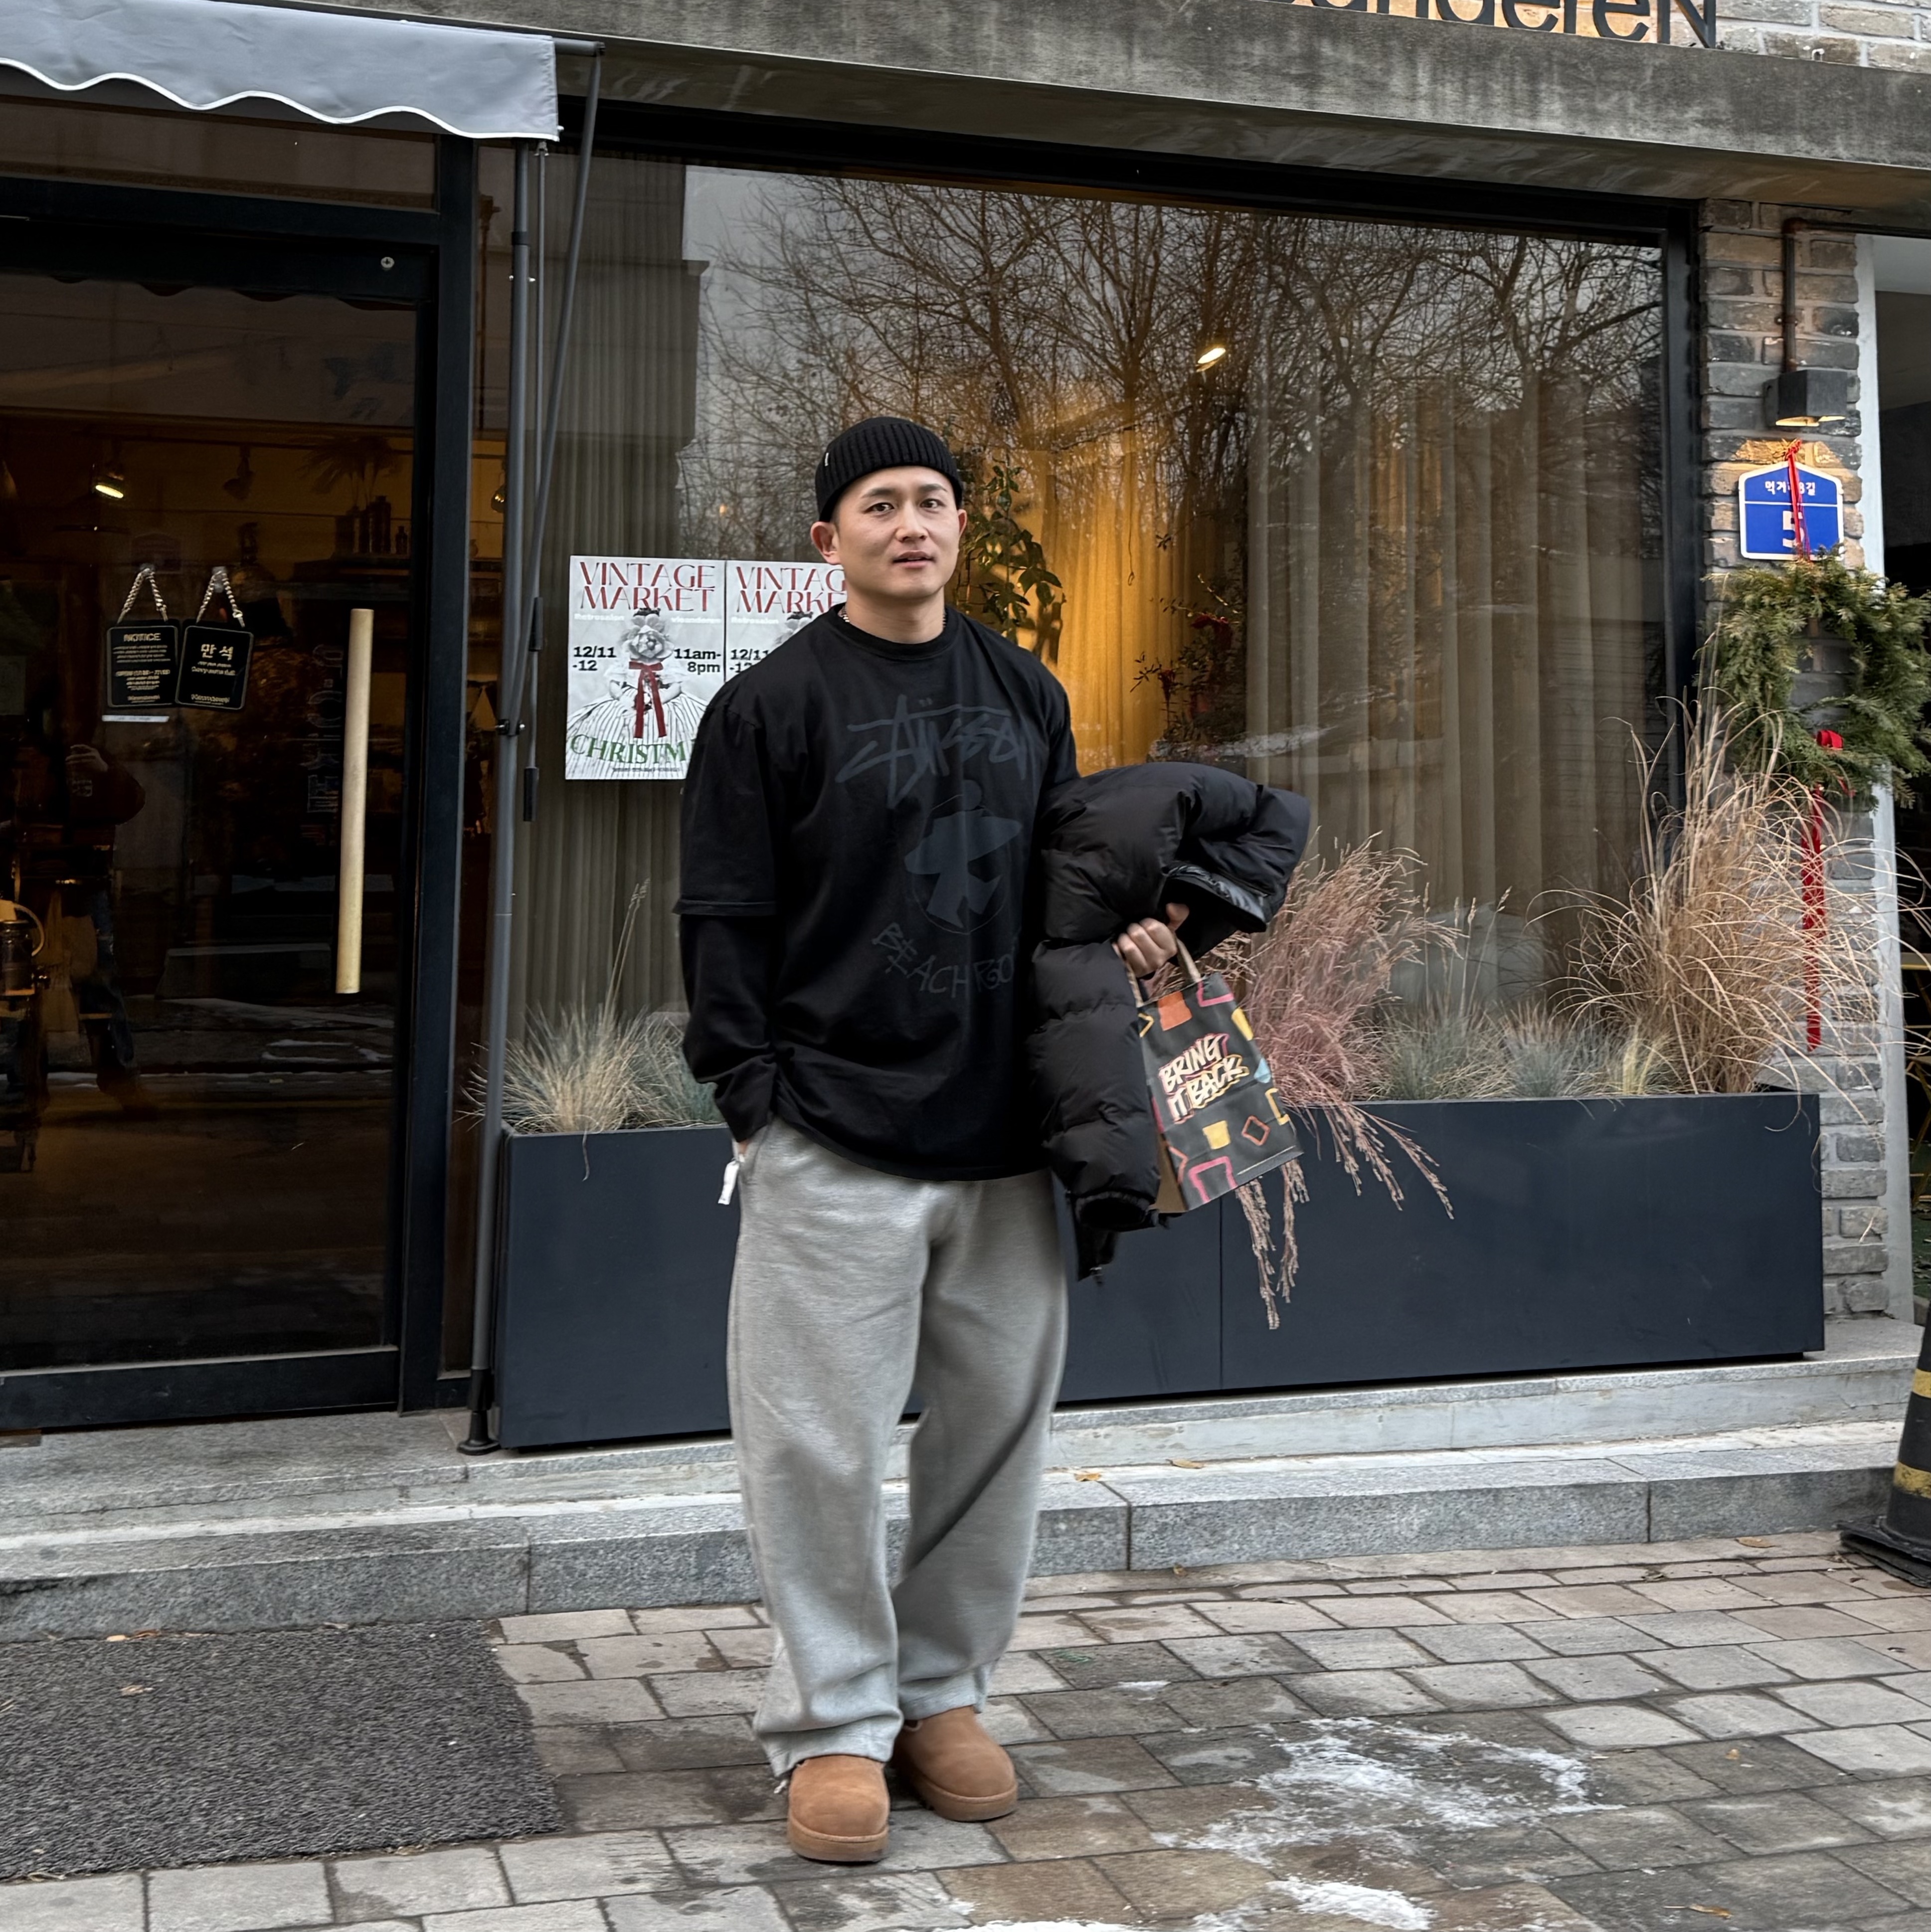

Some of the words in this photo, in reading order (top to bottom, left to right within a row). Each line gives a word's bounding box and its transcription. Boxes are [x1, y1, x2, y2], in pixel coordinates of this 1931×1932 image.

[1765, 481, 1815, 496] 먹거8길
[1783, 510, 1805, 548] 5
[580, 562, 715, 589] VINTAGE
[581, 586, 714, 611] MARKET
[124, 633, 161, 642] NOTICE
[574, 647, 616, 658] 12/11
[674, 649, 721, 660] 11am-
[572, 661, 598, 671] -12
[688, 662, 720, 675] 8pm
[571, 734, 697, 764] CHRISTM
[1159, 1034, 1229, 1095] BRING
[1186, 1054, 1249, 1108] BACK
